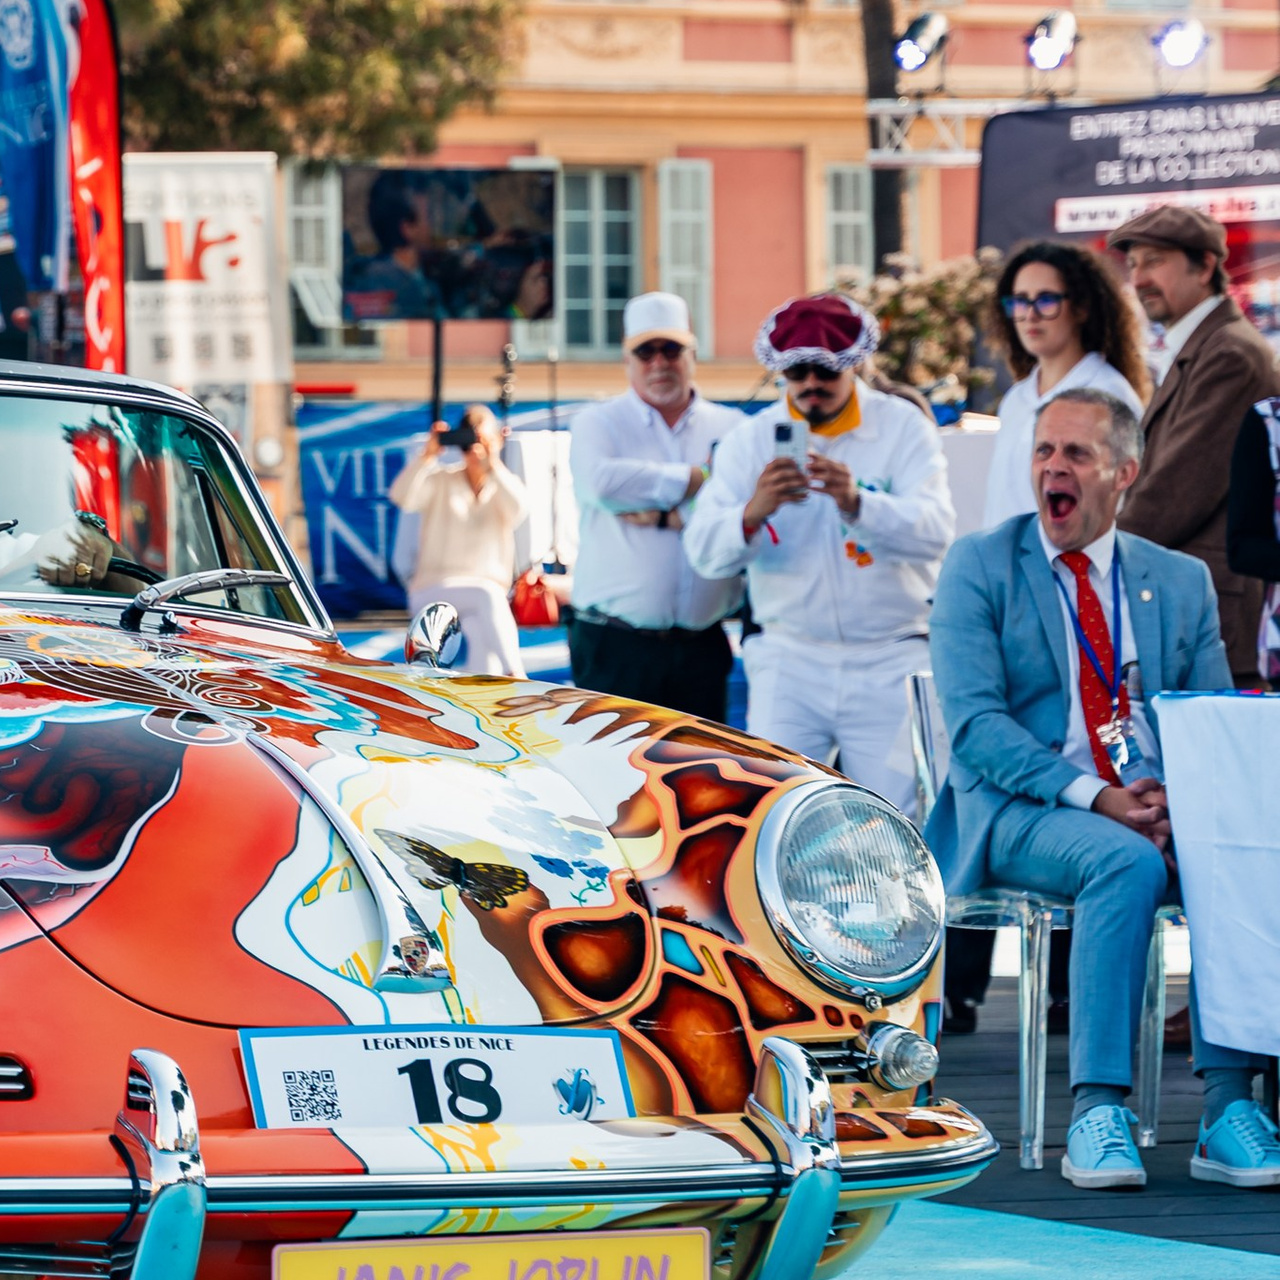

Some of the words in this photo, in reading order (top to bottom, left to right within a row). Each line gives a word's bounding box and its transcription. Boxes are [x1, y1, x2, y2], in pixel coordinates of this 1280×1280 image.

[1149, 105, 1206, 136] DANS
[1096, 160, 1126, 186] DE
[1127, 158, 1156, 184] LA
[362, 1036, 451, 1051] LEGENDES
[454, 1037, 476, 1050] DE
[478, 1037, 516, 1051] NICE
[397, 1057, 502, 1124] 18
